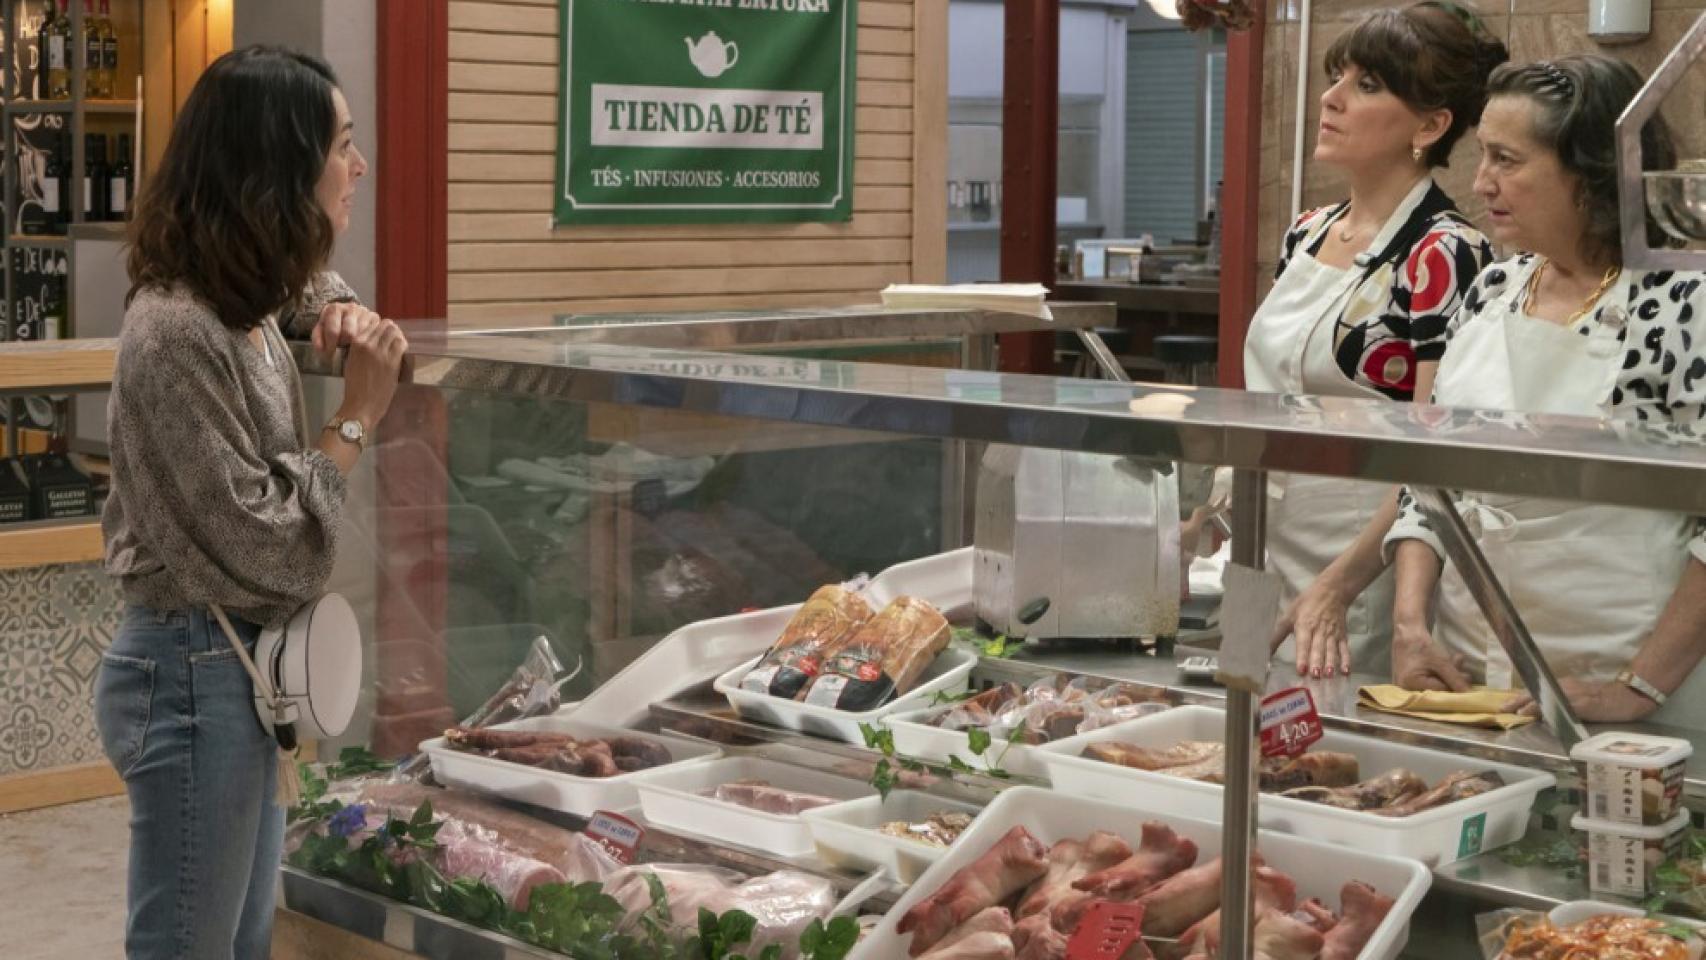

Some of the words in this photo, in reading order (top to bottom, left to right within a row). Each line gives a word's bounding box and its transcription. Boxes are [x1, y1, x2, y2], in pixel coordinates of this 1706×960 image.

[605, 100, 726, 133] TIENDA
[734, 104, 769, 134] DE
[775, 98, 811, 135] TÉ
[591, 165, 622, 187] TÉS
[635, 169, 723, 187] INFUSIONES
[734, 171, 821, 187] ACCESORIOS
